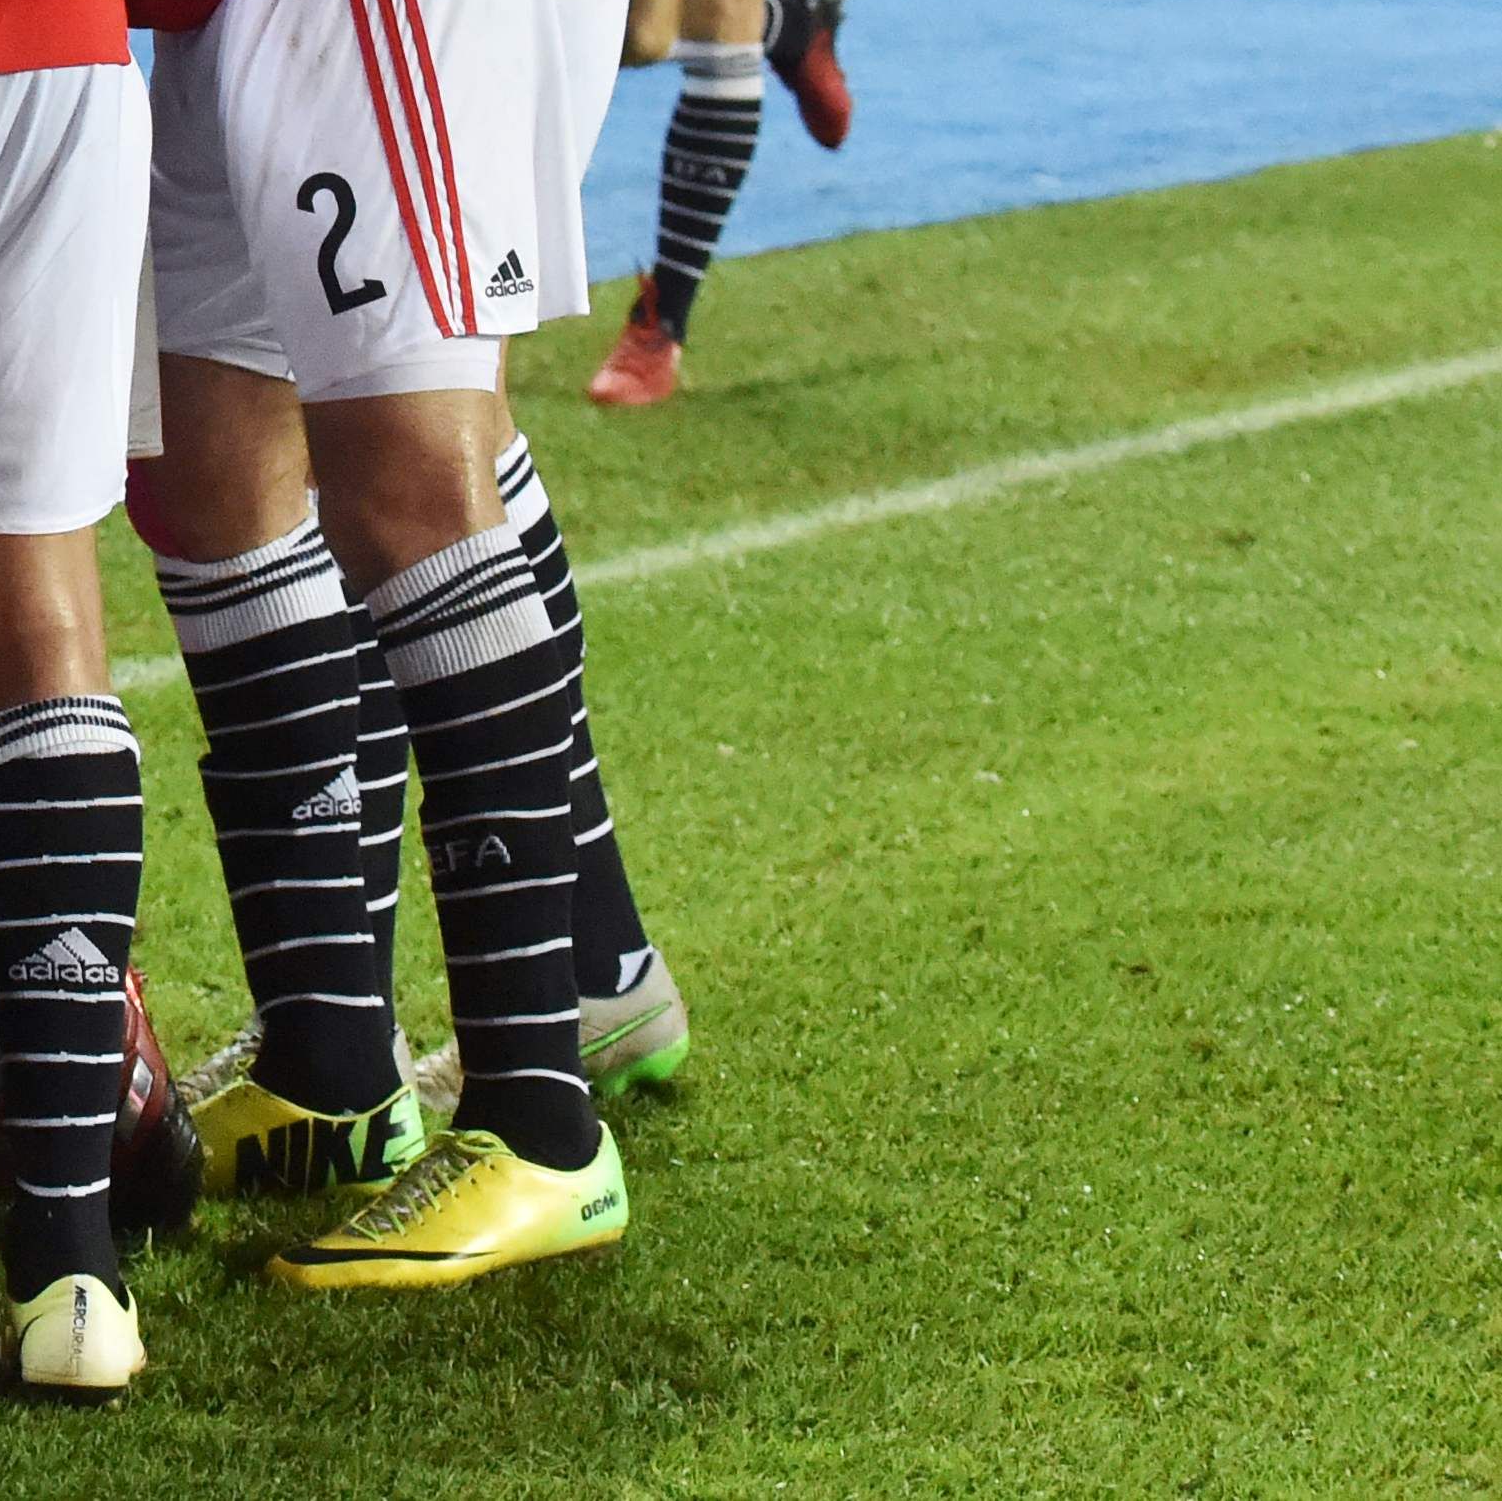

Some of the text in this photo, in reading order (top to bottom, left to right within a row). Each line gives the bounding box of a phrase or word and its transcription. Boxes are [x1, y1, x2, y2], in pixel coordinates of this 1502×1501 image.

[296, 172, 387, 316] 2
[485, 278, 534, 298] adidas
[8, 961, 119, 984] adidas
[235, 1092, 409, 1196] NIKE
